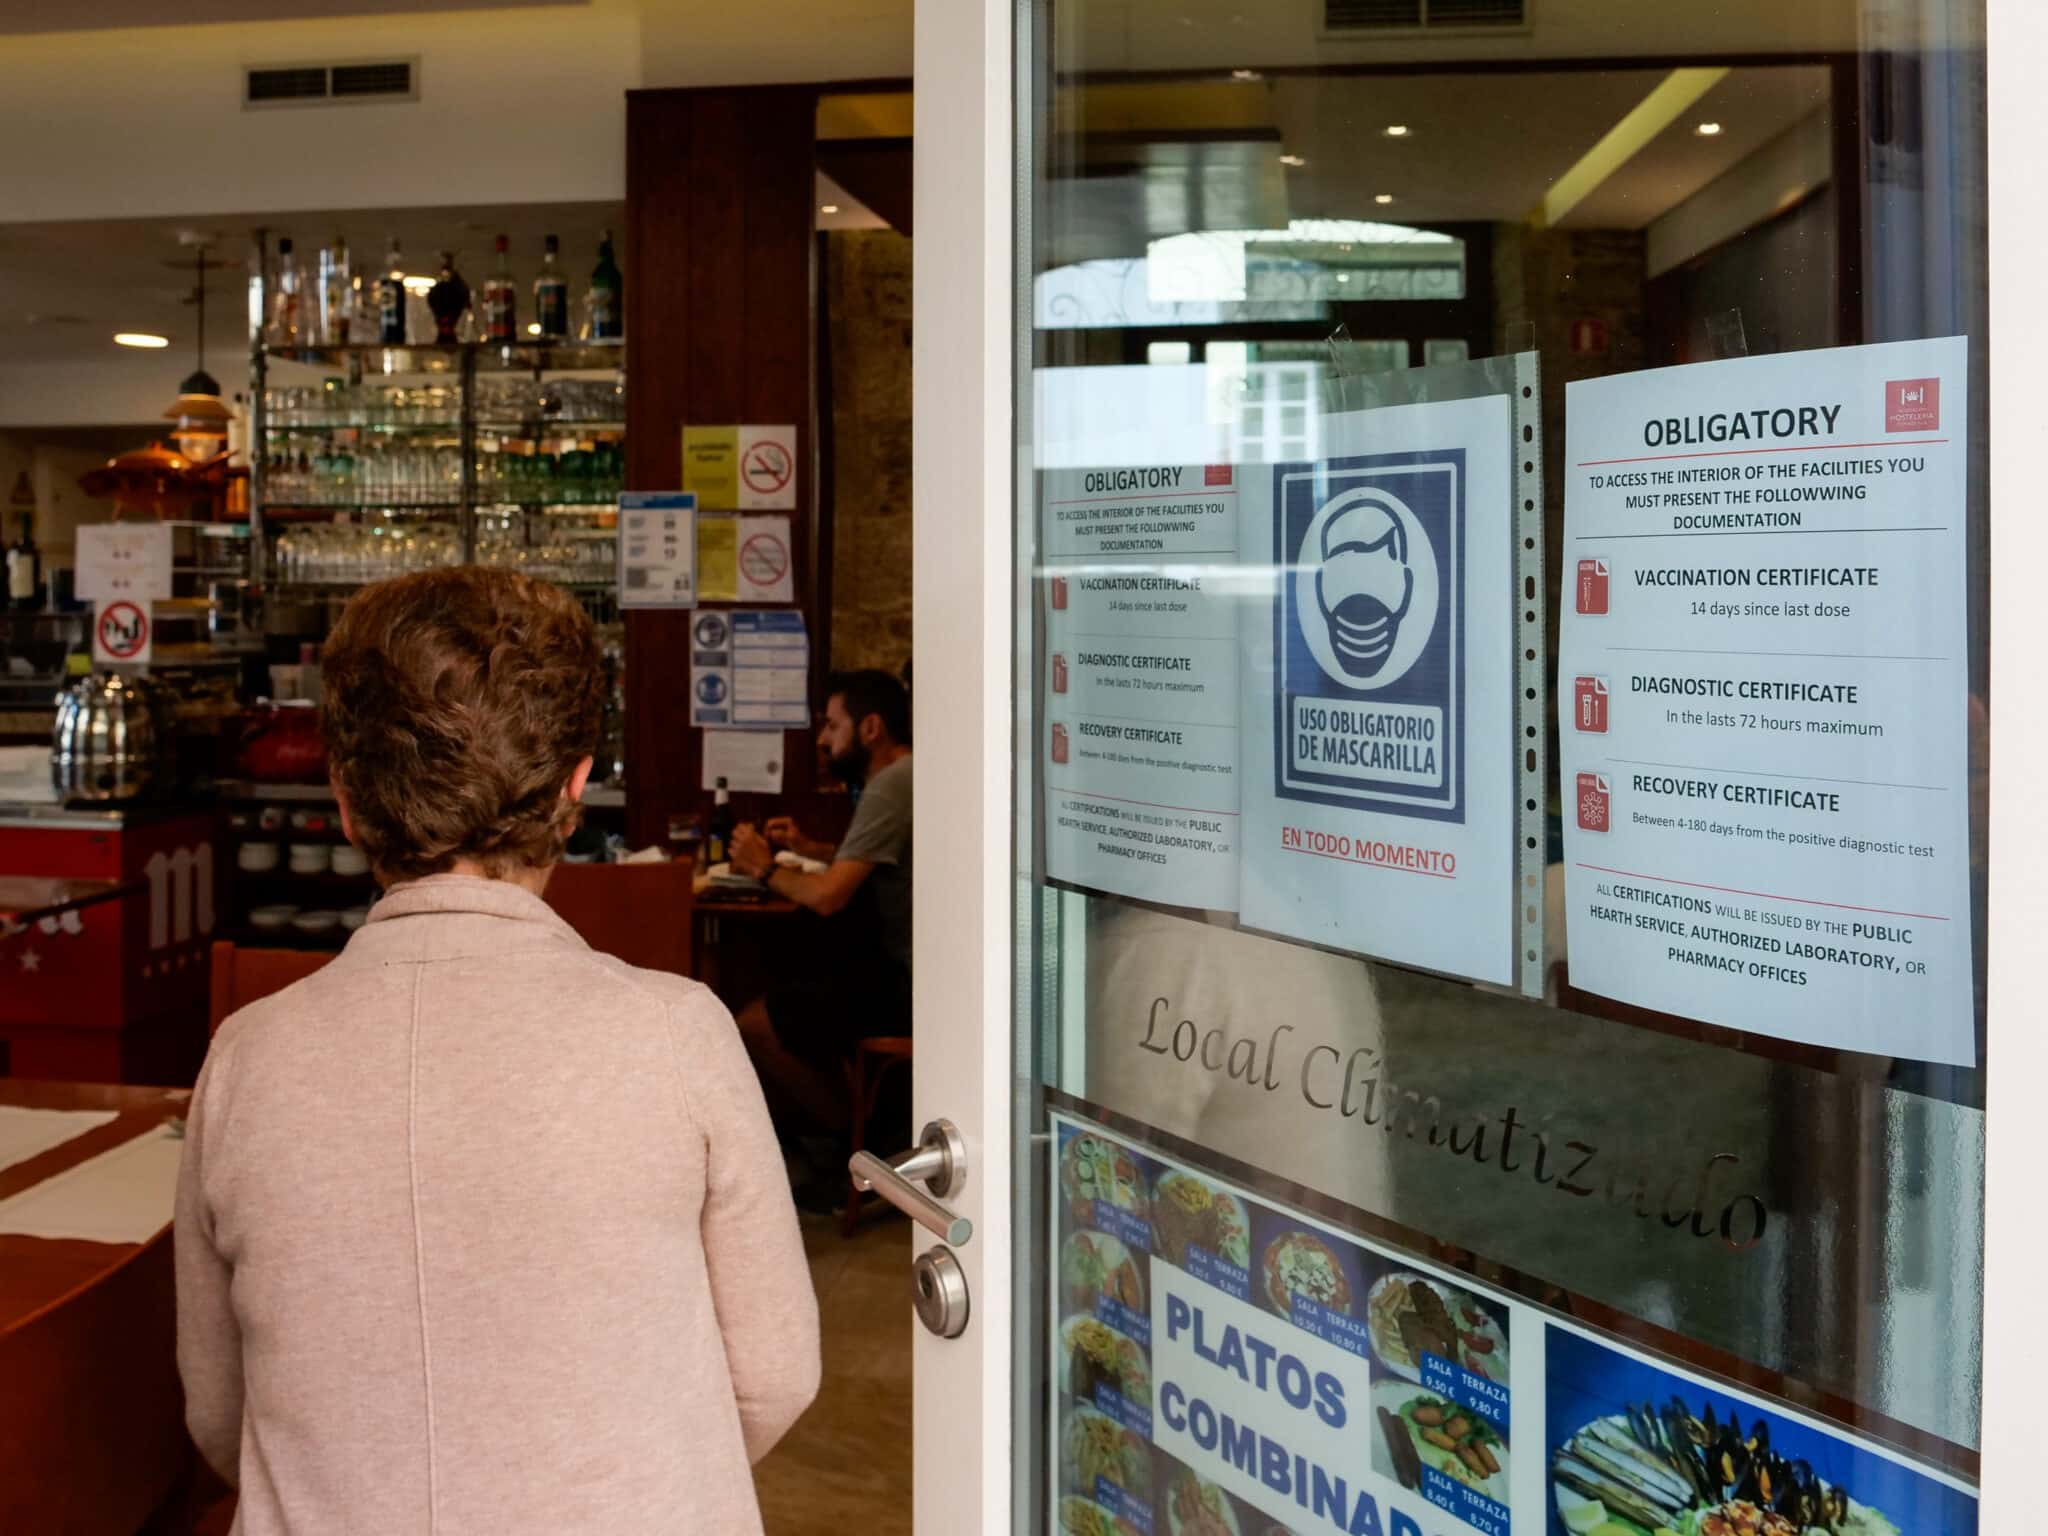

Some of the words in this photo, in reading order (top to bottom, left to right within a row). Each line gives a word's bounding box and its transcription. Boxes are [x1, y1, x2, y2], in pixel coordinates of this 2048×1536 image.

[1644, 404, 1841, 447] OBLIGATORY
[1085, 466, 1183, 492] OBLIGATORY
[1590, 475, 1604, 489] TO
[1606, 472, 1647, 487] ACCESS
[1651, 470, 1674, 485] THE
[1677, 467, 1741, 483] INTERIOR
[1745, 466, 1764, 480] OF
[1768, 464, 1796, 478] THE
[1801, 459, 1883, 476] FACILITIES
[1888, 457, 1924, 473] YOU
[1066, 510, 1087, 520] ACCESS
[1089, 509, 1100, 519] THE
[1102, 507, 1133, 519] INTERIOR
[1135, 506, 1145, 516] OF
[1147, 505, 1160, 515] THE
[1162, 504, 1203, 515] FACILITIES
[1205, 503, 1224, 513] YOU
[1626, 495, 1660, 509] MUST
[1663, 492, 1719, 507] PRESENT
[1724, 490, 1751, 505] THE
[1755, 485, 1866, 502] FOLLOWWING
[1075, 525, 1093, 535] MUST
[1095, 524, 1124, 535] PRESENT
[1126, 523, 1139, 533] THE
[1140, 521, 1195, 532] FOLLOWWING
[1673, 512, 1801, 530] DOCUMENTATION
[1100, 539, 1163, 550] DOCUMENTATION
[1080, 577, 1138, 591] VACCINATION
[1140, 577, 1200, 591] CERTIFICATE
[1634, 568, 1751, 587] VACCINATION
[1756, 568, 1879, 586] CERTIFICATE
[1109, 602, 1117, 610] 14
[1119, 601, 1133, 613] days
[1135, 601, 1152, 611] since
[1154, 601, 1167, 611] last
[1169, 601, 1187, 612] dose
[1691, 602, 1706, 615] 14
[1710, 601, 1741, 619] days
[1744, 602, 1780, 616] since
[1784, 602, 1809, 617] last
[1814, 603, 1850, 617] dose
[1078, 653, 1130, 668] DIAGNOSTIC
[1132, 656, 1191, 671] CERTIFICATE
[1097, 677, 1102, 685] In
[1103, 677, 1114, 687] the
[1116, 678, 1131, 689] lasts
[1132, 679, 1140, 689] 72
[1142, 679, 1163, 690] hours
[1165, 682, 1204, 693] maximum
[1631, 675, 1734, 698] DIAGNOSTIC
[1738, 680, 1858, 703] CERTIFICATE
[1080, 723, 1122, 739] RECOVERY
[1124, 728, 1182, 745] CERTIFICATE
[1300, 707, 1327, 731] USO
[1330, 710, 1435, 742] OBLIGATORIO
[1666, 710, 1678, 723] In
[1682, 710, 1703, 725] the
[1706, 712, 1736, 727] lasts
[1740, 714, 1757, 728] 72
[1761, 715, 1802, 732] hours
[1807, 720, 1883, 736] maximum
[1144, 756, 1155, 766] the
[1181, 761, 1216, 774] diagnostic
[1218, 764, 1232, 773] test
[1299, 734, 1318, 761] DE
[1322, 736, 1436, 775] MASCARILLA
[1633, 775, 1718, 800] RECOVERY
[1723, 784, 1840, 812] CERTIFICATE
[1070, 801, 1120, 818] CERTIFICATIONS
[1189, 820, 1222, 833] PUBLIC
[1109, 826, 1153, 843] AUTHORIZED
[1155, 833, 1216, 853] LABORATORY,
[1282, 826, 1301, 846] EN
[1306, 830, 1350, 856] TODO
[1356, 839, 1456, 874] MOMENTO
[1632, 812, 1675, 829] Between
[1678, 817, 1707, 831] 4-180
[1710, 820, 1734, 837] days
[1736, 824, 1763, 839] from
[1766, 829, 1786, 842] the
[1789, 831, 1836, 848] positive
[1839, 835, 1904, 855] diagnostic
[1908, 843, 1935, 858] test
[1098, 843, 1135, 859] PHARMACY
[1137, 849, 1167, 864] OFFICES
[1596, 883, 1611, 897] ALL
[1613, 885, 1712, 914] CERTIFICATIONS
[1715, 905, 1741, 920] WILL
[1744, 909, 1757, 922] BE
[1761, 911, 1802, 930] ISSUED
[1806, 917, 1821, 932] BY
[1824, 921, 1849, 936] THE
[1852, 923, 1912, 944] PUBLIC
[1590, 905, 1632, 926] HEARTH
[1635, 914, 1688, 938] SERVICE,
[1691, 924, 1781, 953] AUTHORIZED
[1785, 940, 1901, 973] LABORATORY,
[1905, 961, 1926, 975] OR
[1668, 947, 1744, 974] PHARMACY
[1749, 962, 1807, 985] OFFICES
[1138, 997, 1295, 1091] Local
[1190, 1248, 1207, 1264] SALA
[1214, 1260, 1248, 1282] TERRAZA
[1297, 1299, 1318, 1315] SALA
[1326, 1312, 1367, 1339] TERRAZA
[1166, 1292, 1347, 1428] PLATOS
[1428, 1358, 1452, 1378] SALA
[1462, 1373, 1508, 1405] TERRAZA
[1426, 1375, 1446, 1393] 9,50
[1448, 1386, 1455, 1398] €
[1469, 1396, 1491, 1415] 9,80
[1493, 1408, 1500, 1420] €
[1160, 1380, 1444, 1536] COMBINAD
[1428, 1471, 1453, 1493] SALA
[1462, 1489, 1508, 1523] TERRAZA
[1449, 1501, 1455, 1513] €
[1470, 1513, 1492, 1532] 8,70
